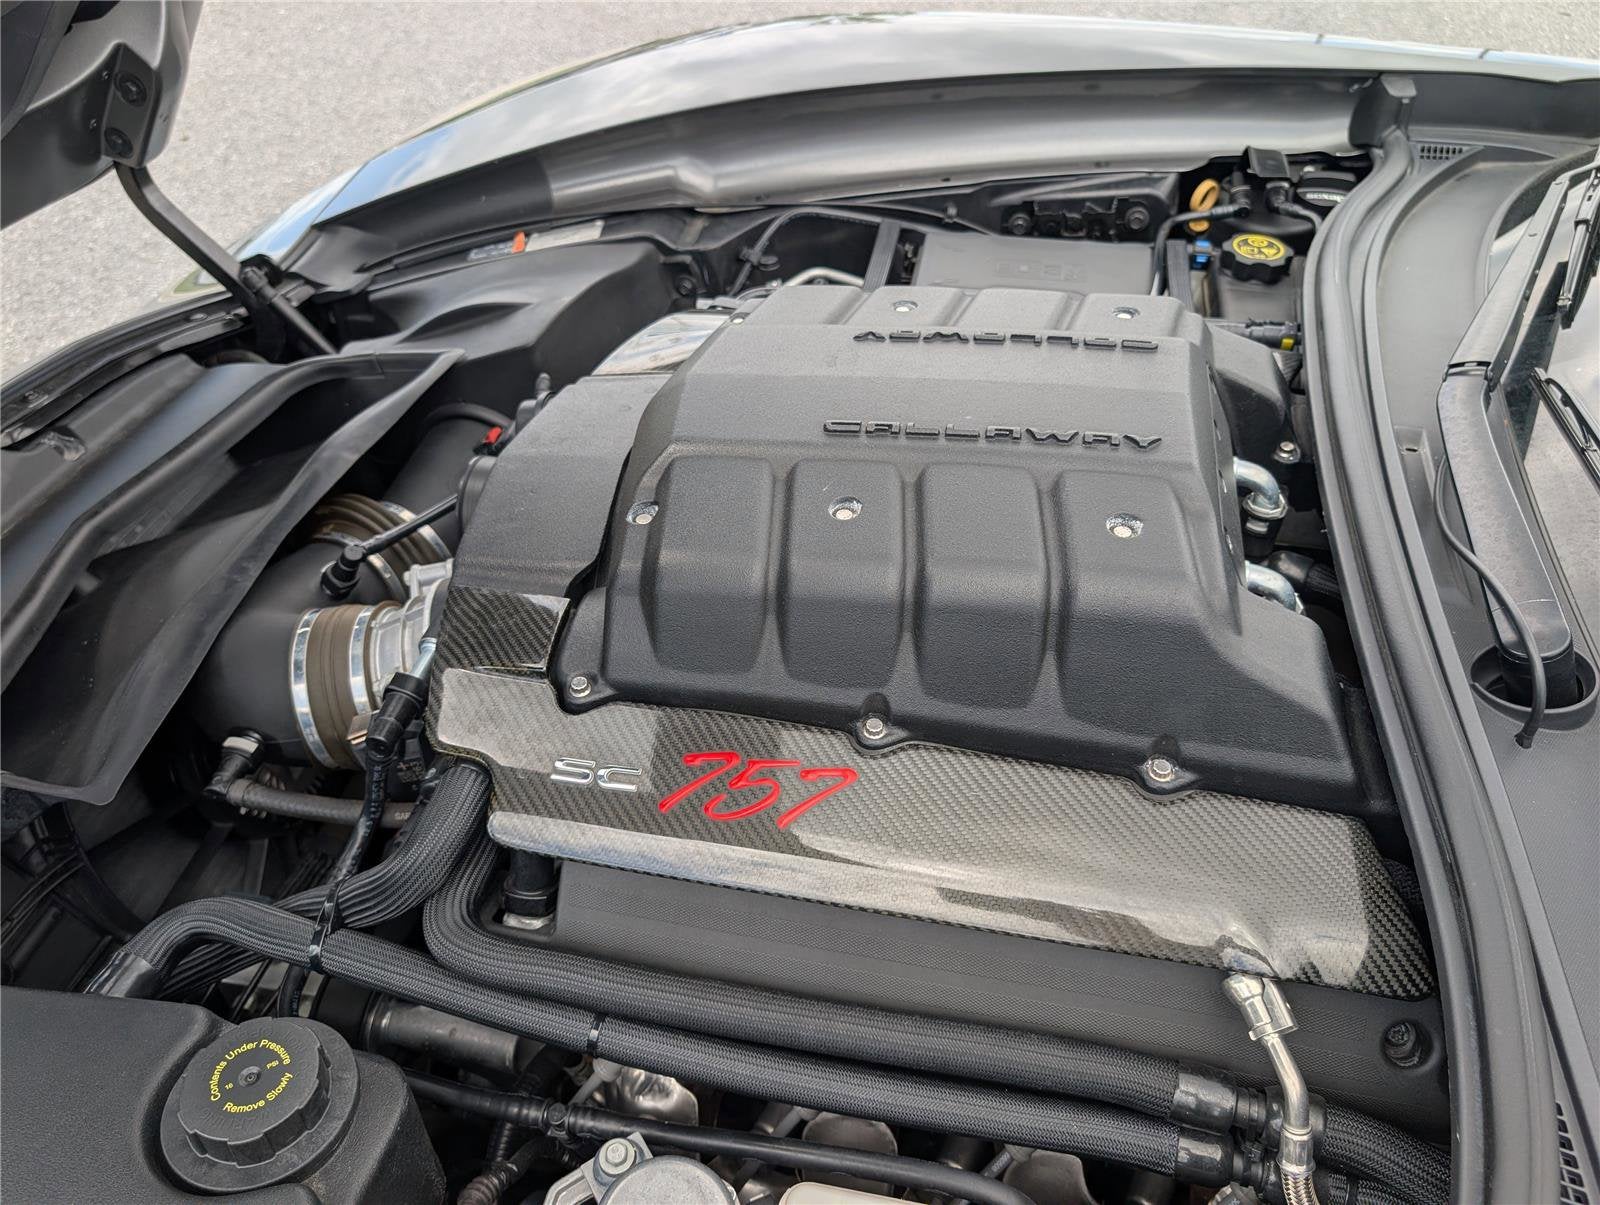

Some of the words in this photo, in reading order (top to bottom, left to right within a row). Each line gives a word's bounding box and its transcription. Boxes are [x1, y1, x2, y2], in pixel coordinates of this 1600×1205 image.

[823, 419, 1162, 449] CALLAWAY
[550, 756, 643, 792] SC
[658, 750, 859, 829] 757
[209, 1060, 227, 1101] Contents
[225, 1041, 258, 1060] Under
[259, 1039, 291, 1065] Pressure
[266, 1060, 279, 1070] PSI
[222, 1099, 266, 1113] Remove
[266, 1072, 294, 1101] Slowly
